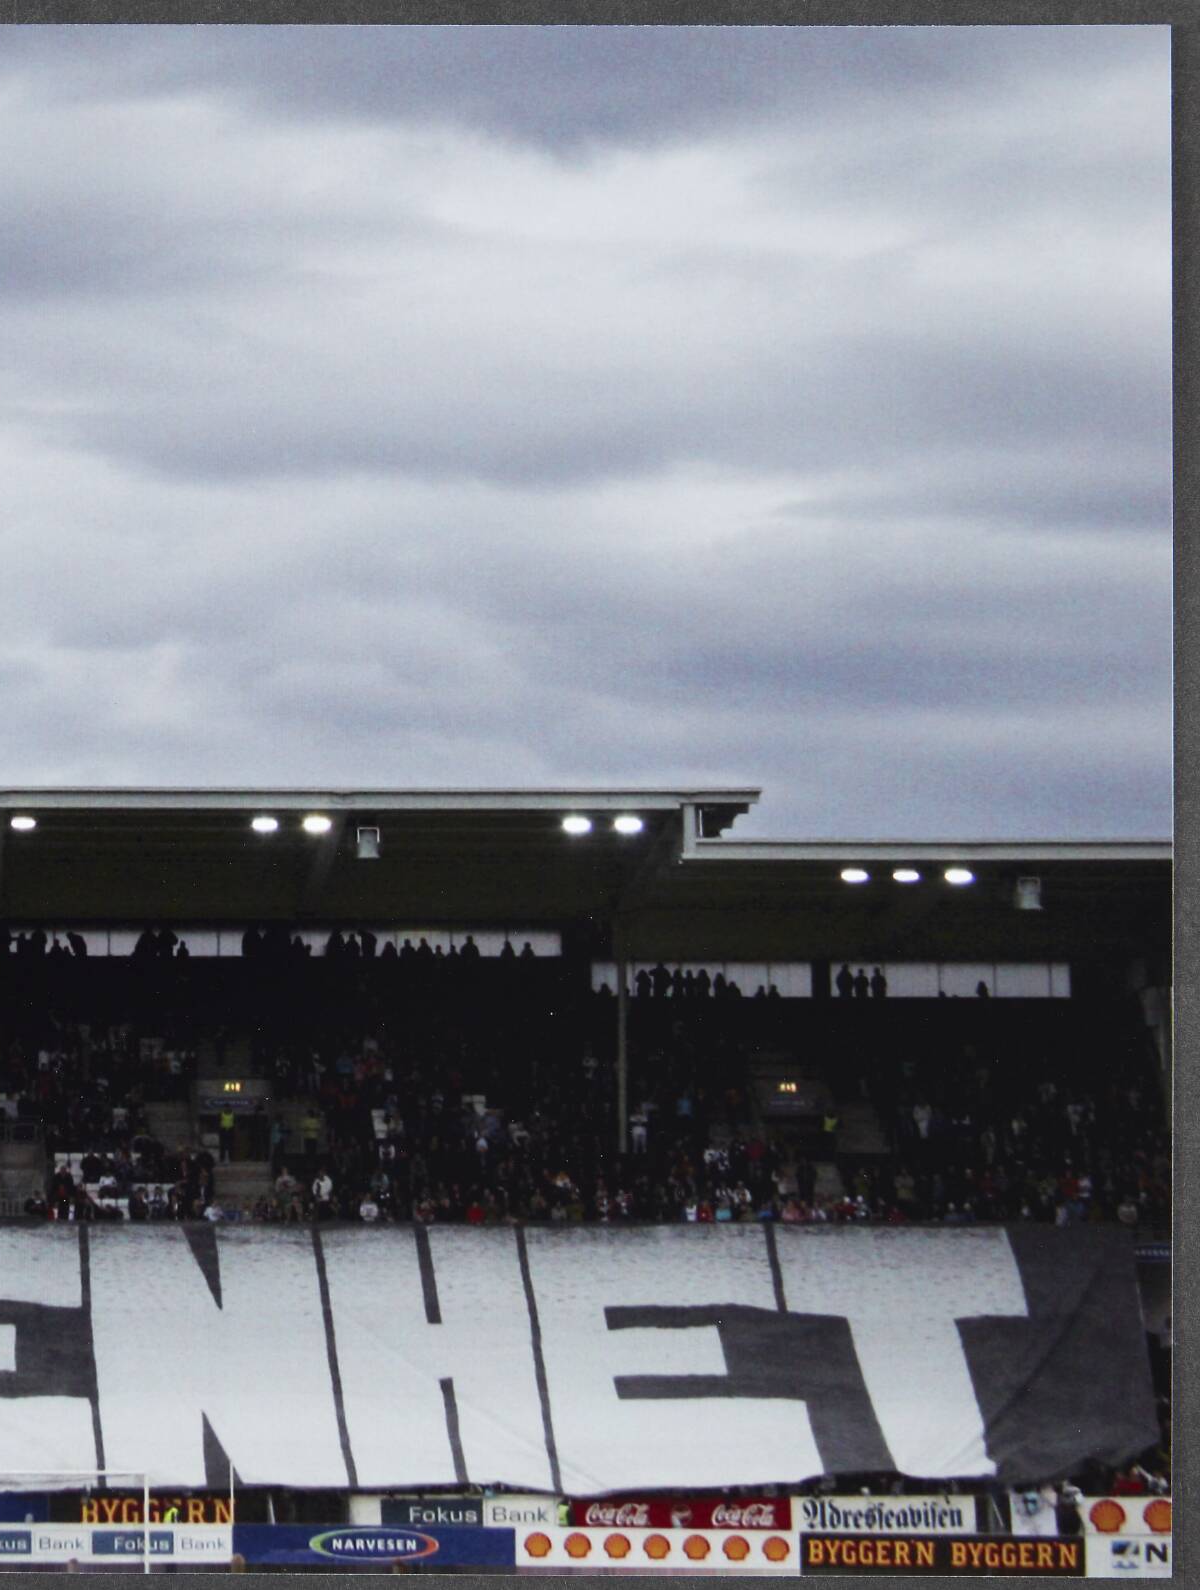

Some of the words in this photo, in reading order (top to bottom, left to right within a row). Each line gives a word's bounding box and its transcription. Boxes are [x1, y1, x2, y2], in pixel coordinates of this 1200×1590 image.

[408, 1505, 477, 1523] Fokus
[491, 1505, 550, 1523] Bank
[585, 1503, 649, 1527] Coca-Cola
[38, 1537, 85, 1551] Bank
[113, 1537, 170, 1552] Fokus
[180, 1538, 226, 1552] Bank
[332, 1538, 418, 1552] NARVESEN
